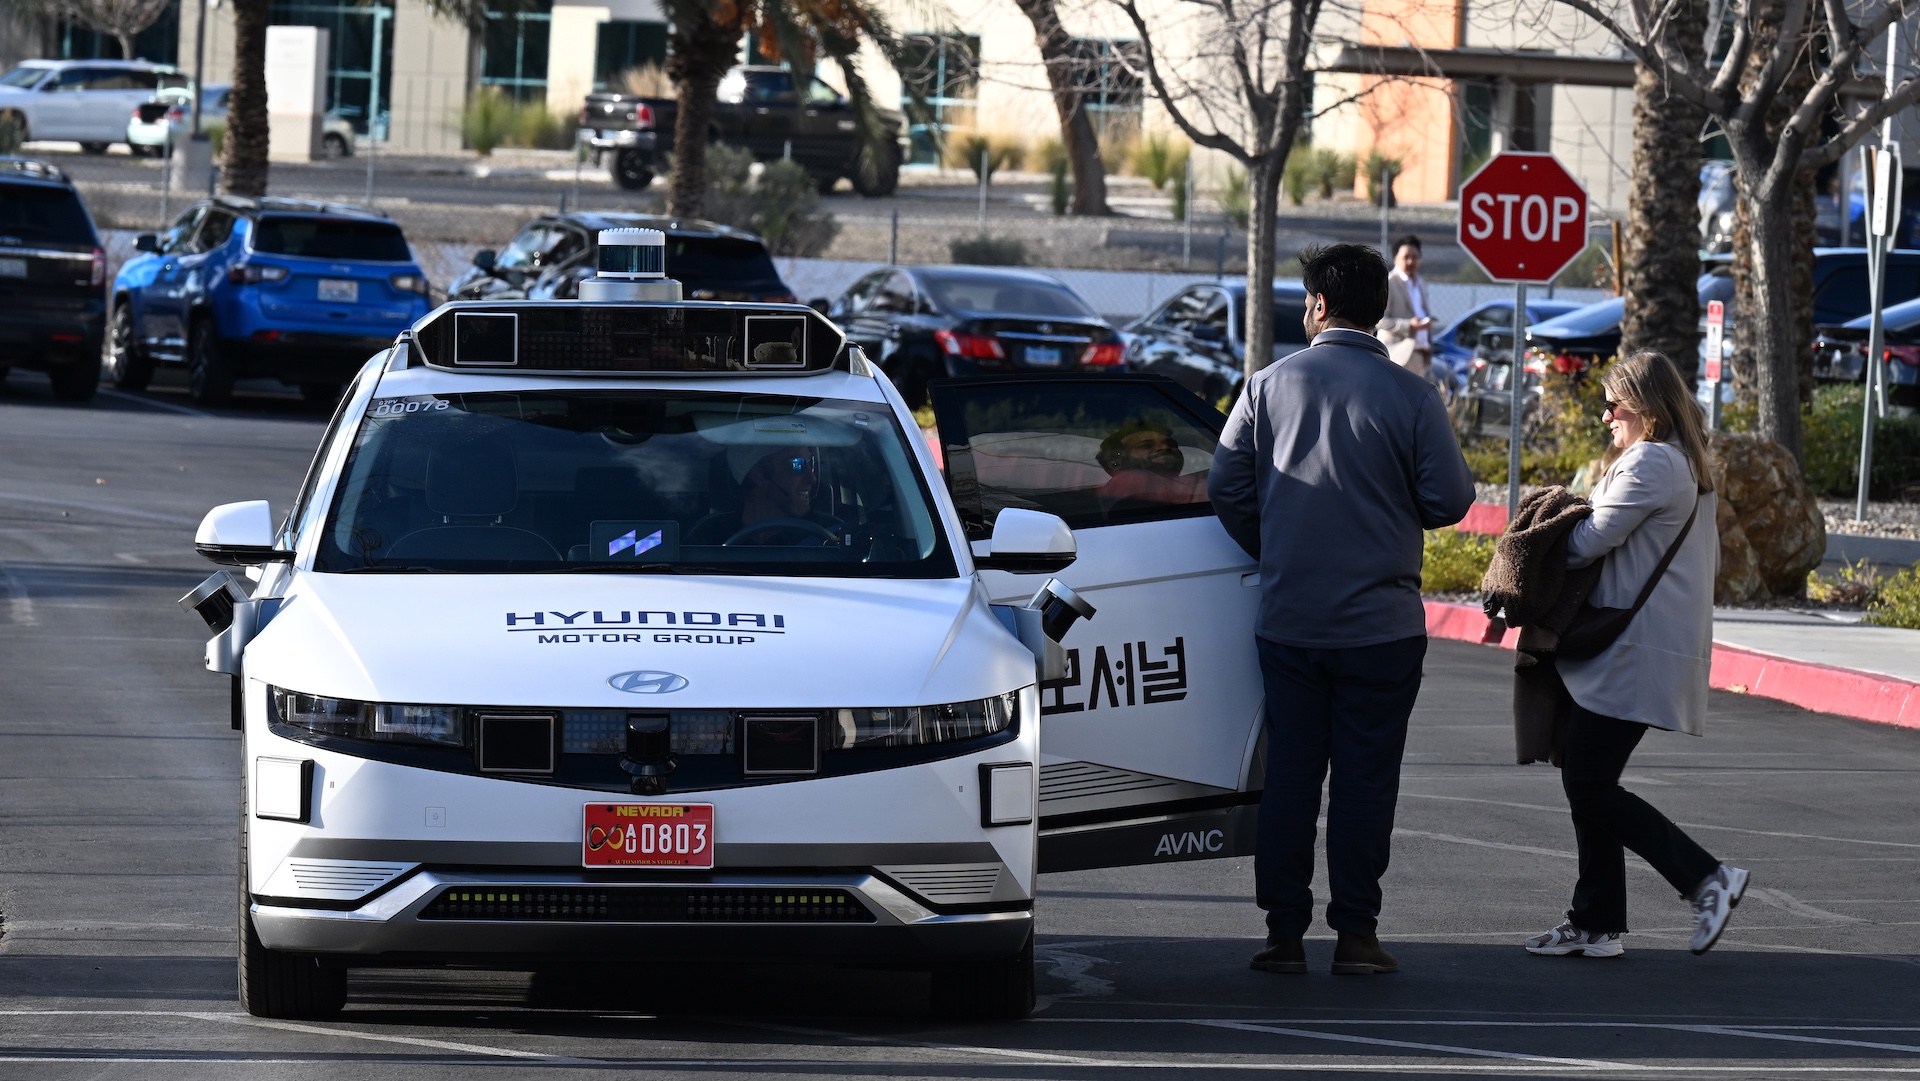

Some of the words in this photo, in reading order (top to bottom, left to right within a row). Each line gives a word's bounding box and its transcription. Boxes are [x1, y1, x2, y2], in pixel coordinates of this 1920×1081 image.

[1468, 192, 1579, 242] STOP
[375, 400, 450, 416] 00078
[506, 610, 785, 629] HYUNDAI
[538, 633, 642, 645] MOTOR
[653, 633, 756, 646] GROUP
[616, 806, 683, 817] NEVADA
[1154, 829, 1224, 857] AVNC
